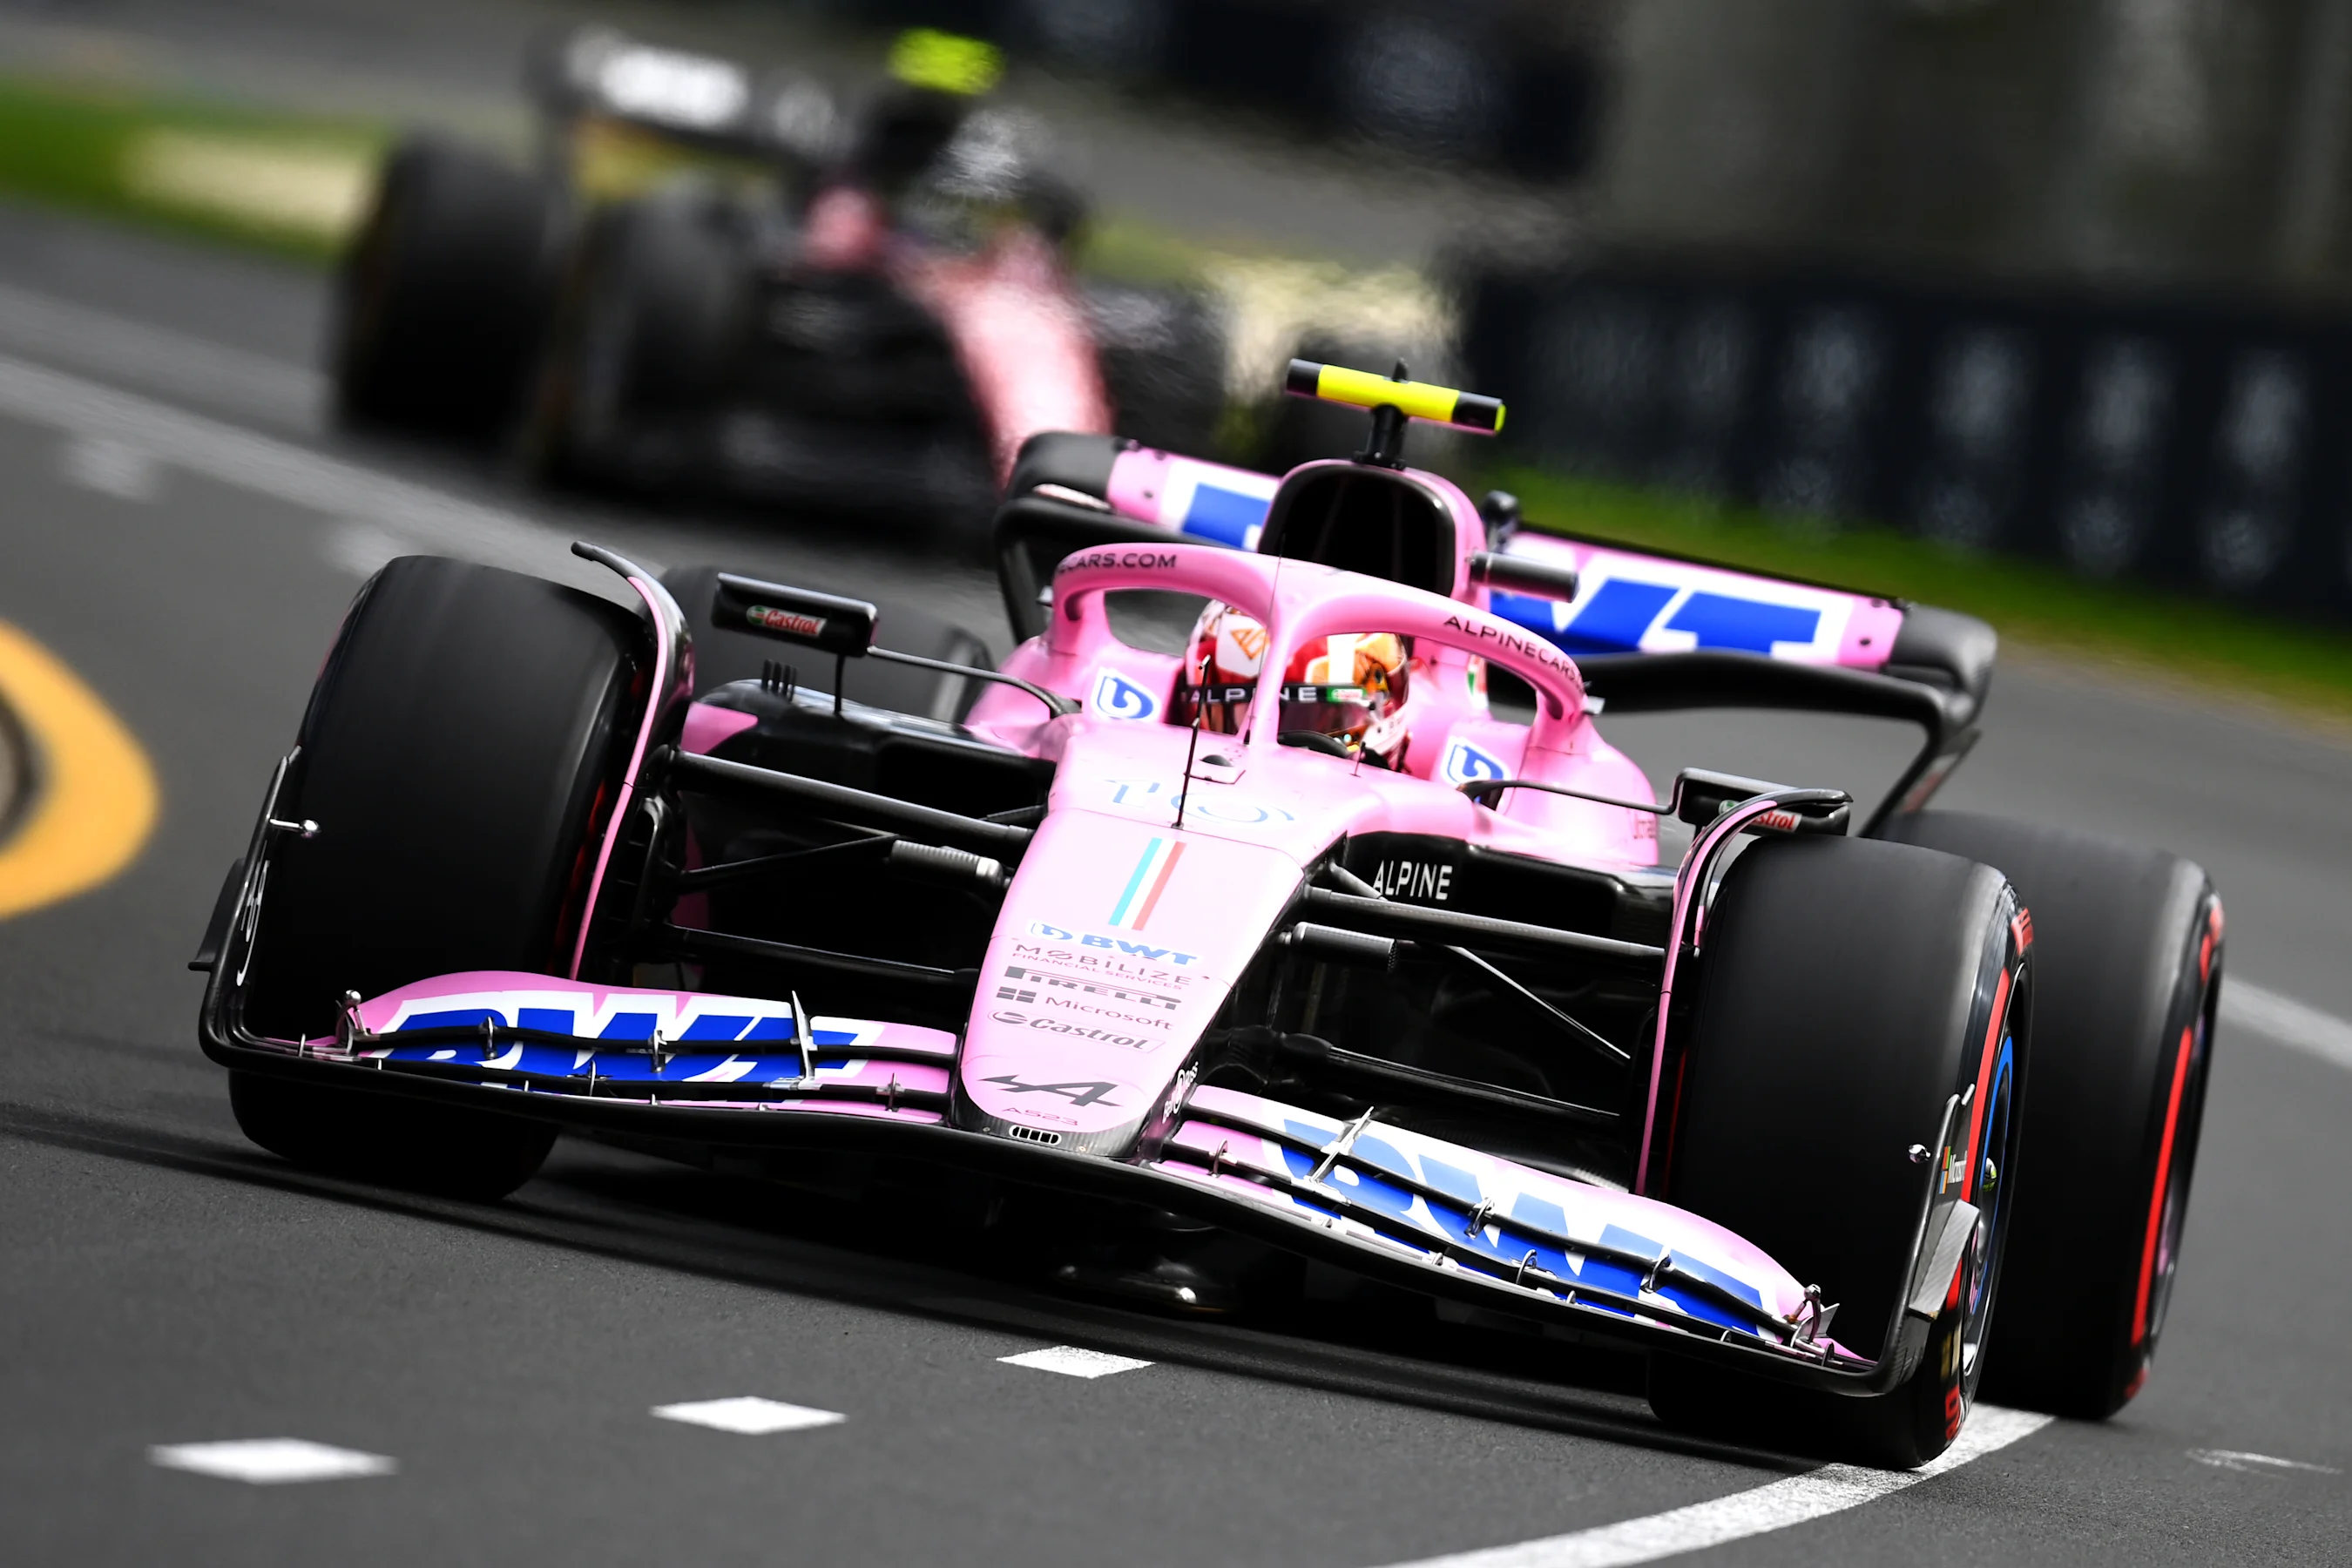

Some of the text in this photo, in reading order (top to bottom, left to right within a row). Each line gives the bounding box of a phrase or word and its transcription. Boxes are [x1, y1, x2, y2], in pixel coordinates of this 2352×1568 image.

[1373, 859, 1453, 901] ALPINE
[1081, 934, 1198, 966] BWT
[1004, 965, 1182, 1010] PIRELLI
[1011, 953, 1183, 990] FINANCIAL SERVICES
[1045, 997, 1174, 1031] Microsoft
[1029, 1018, 1149, 1050] Castrol
[1001, 1107, 1078, 1125] A523
